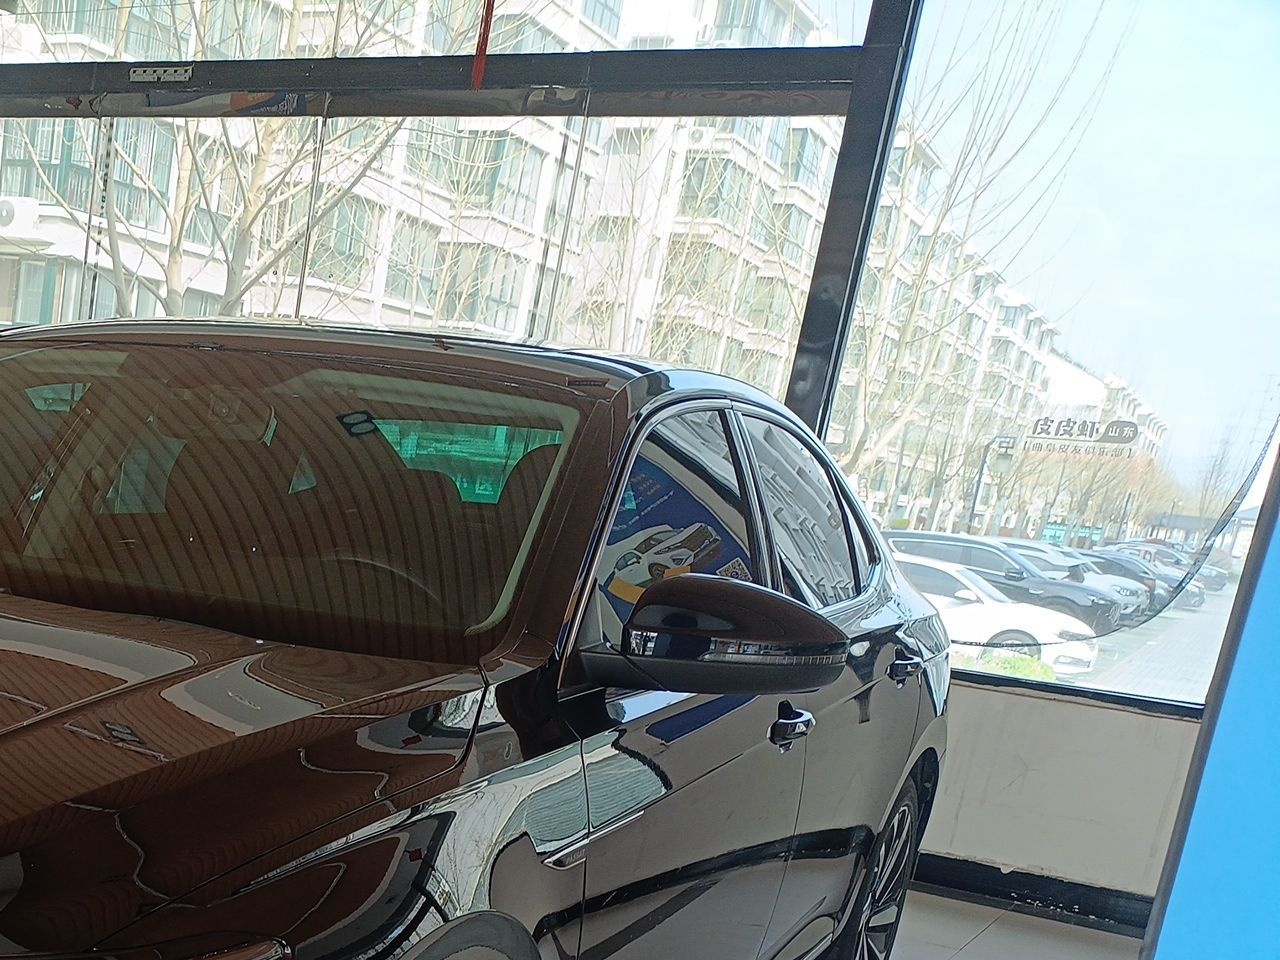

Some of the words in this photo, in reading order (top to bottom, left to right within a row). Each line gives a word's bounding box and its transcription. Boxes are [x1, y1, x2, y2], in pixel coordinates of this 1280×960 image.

[1032, 417, 1101, 438] 皮皮虾
[1108, 425, 1135, 437] 山东
